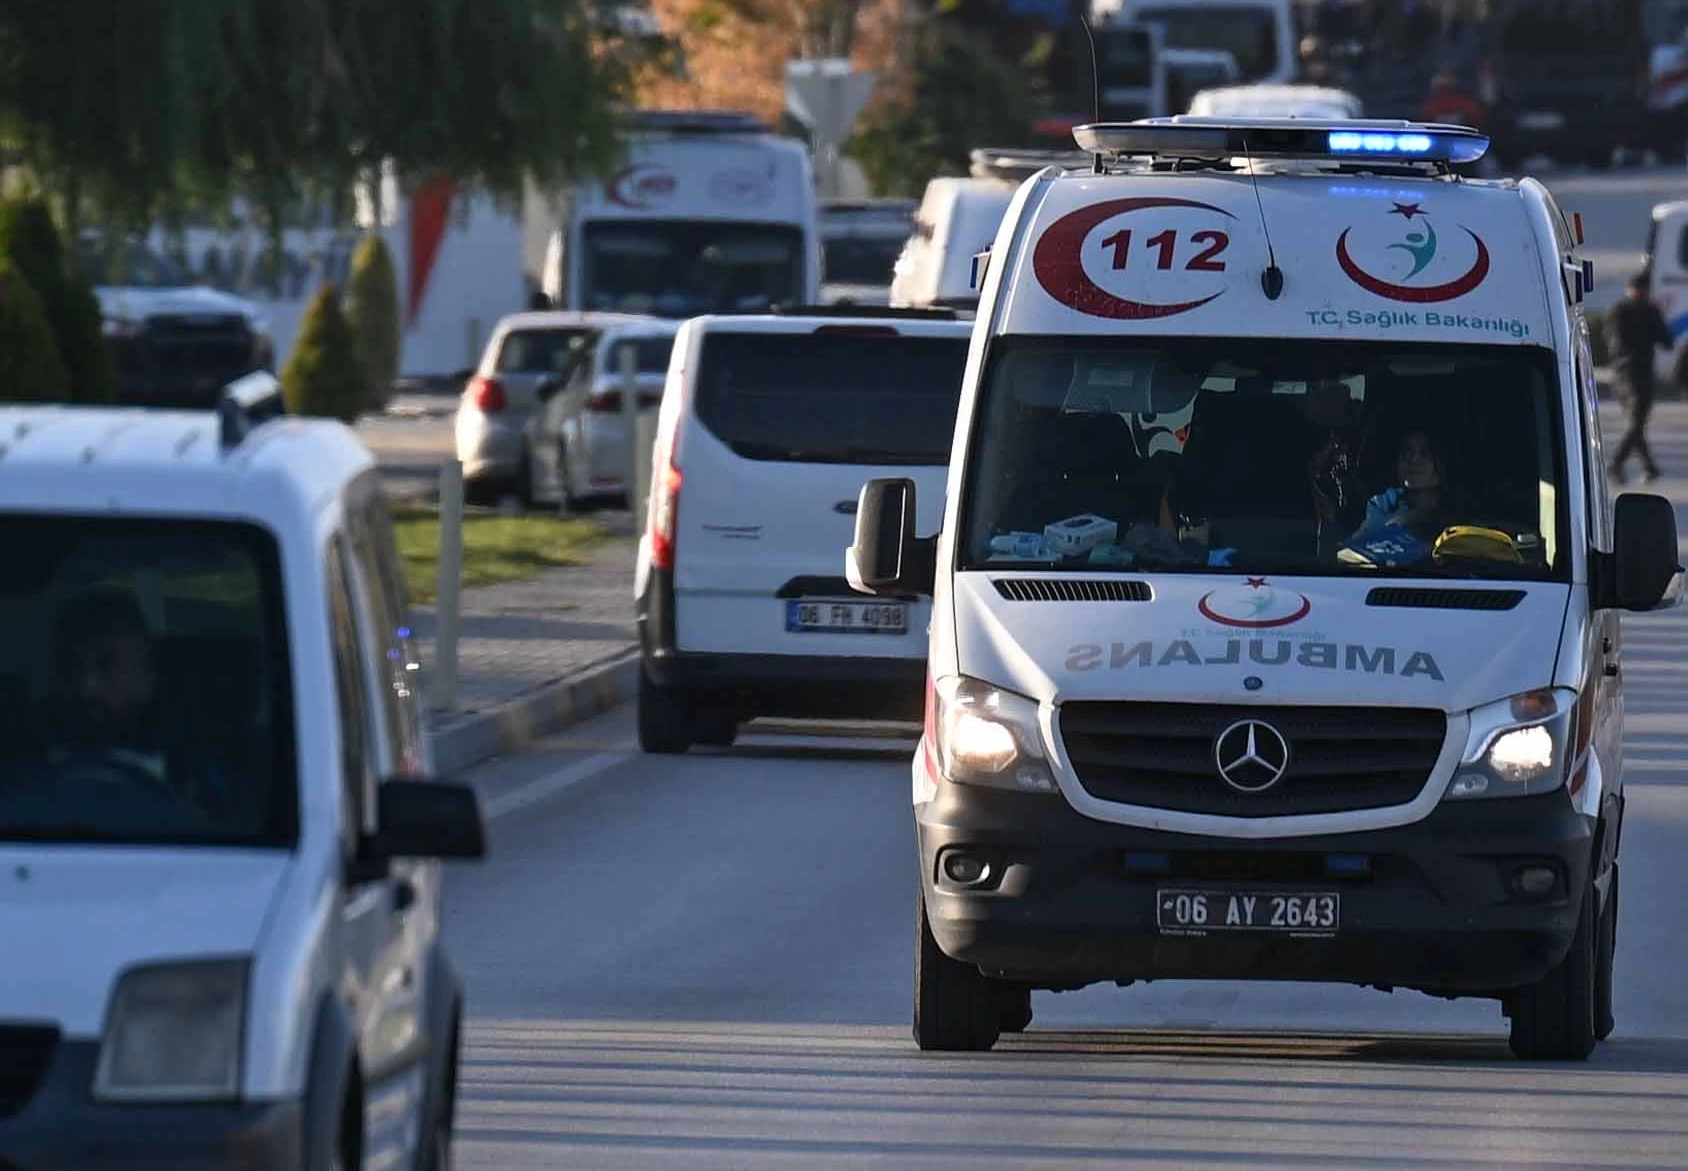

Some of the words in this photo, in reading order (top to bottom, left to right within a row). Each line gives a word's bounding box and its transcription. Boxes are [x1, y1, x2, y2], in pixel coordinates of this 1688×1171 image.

[1101, 229, 1229, 271] 112
[1346, 309, 1417, 328] Sağlık
[1425, 311, 1530, 338] Bakanlığı
[1175, 894, 1208, 925] 06
[1226, 895, 1257, 926] AY
[1270, 896, 1335, 927] 2643
